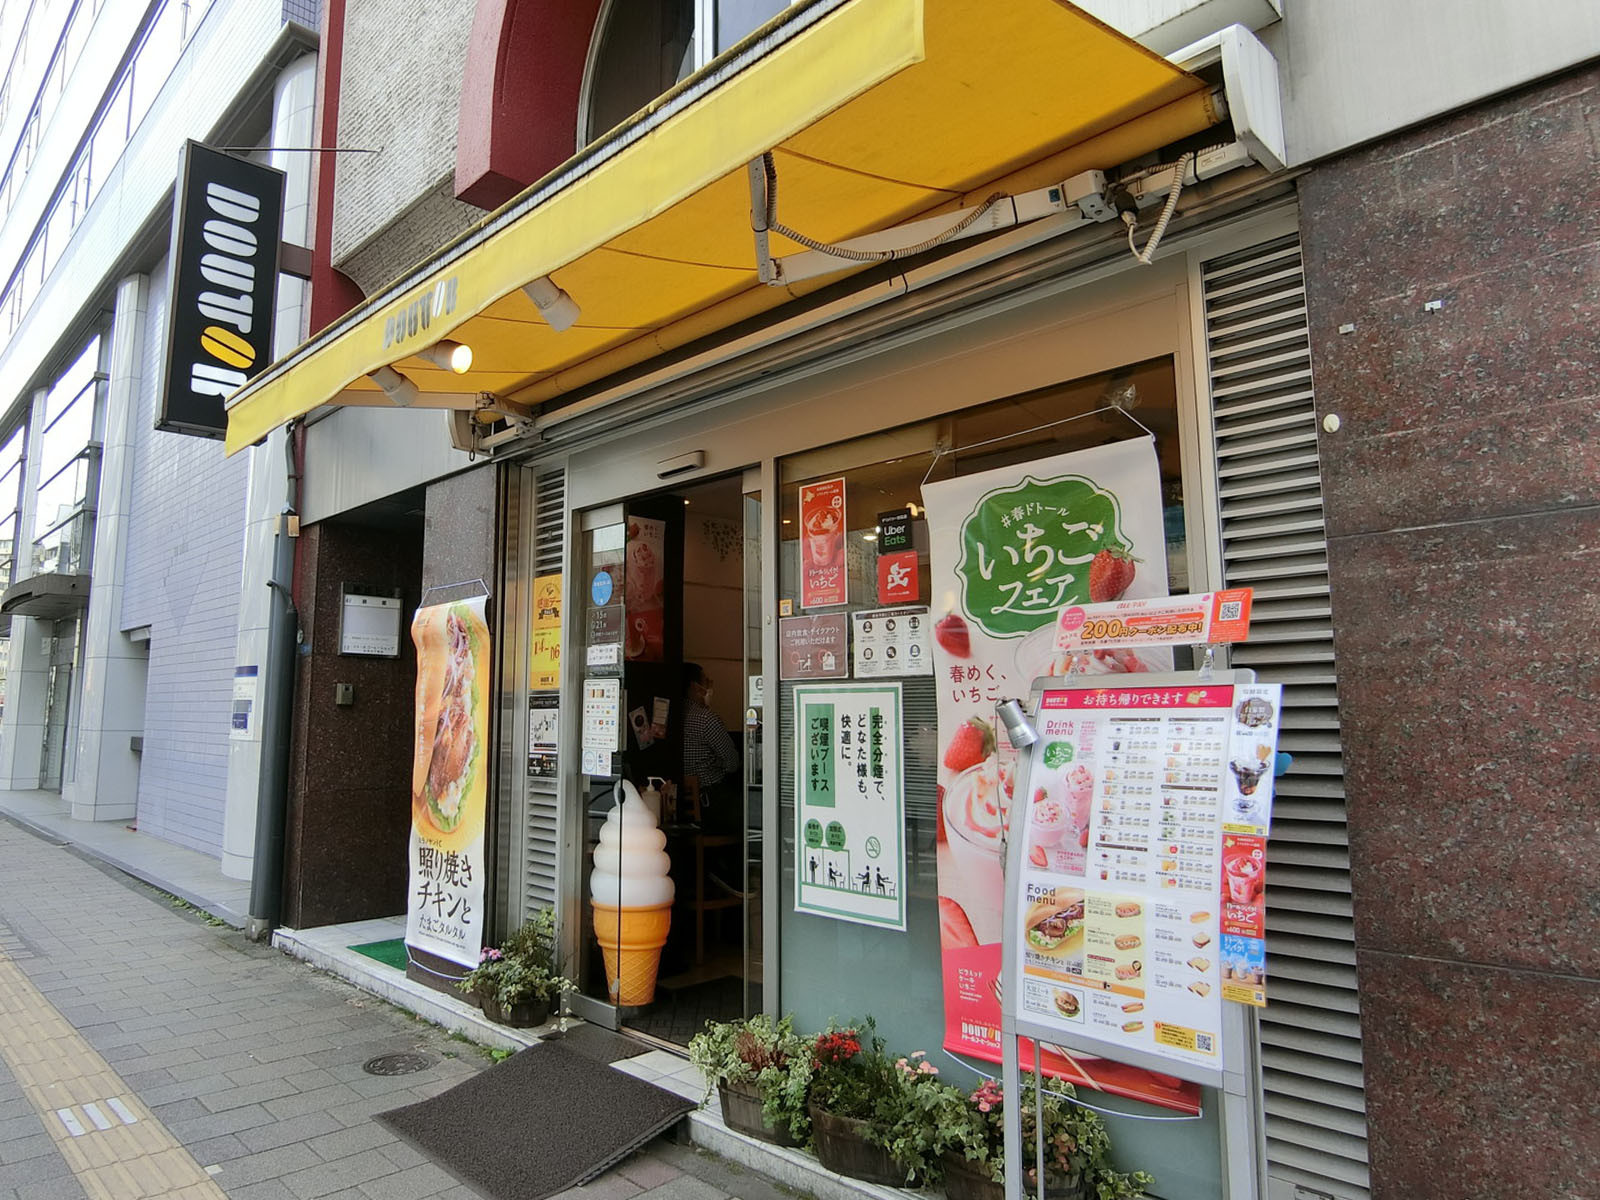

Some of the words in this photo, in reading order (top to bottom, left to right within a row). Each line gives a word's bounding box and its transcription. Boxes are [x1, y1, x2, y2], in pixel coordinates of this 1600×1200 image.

[191, 182, 260, 399] DOUTOR
[384, 276, 458, 351] DOUTOR
[884, 524, 906, 536] Uber
[884, 535, 906, 546] Eats
[977, 522, 1104, 581] いちご
[809, 573, 839, 589] いちご
[991, 573, 1079, 615] フェア
[1081, 619, 1203, 640] 200円クーポン配布中!
[949, 664, 1006, 683] 春めく、
[1083, 692, 1183, 706] お持ち帰りできます
[1045, 728, 1073, 736] menu
[1046, 720, 1074, 729] Drink
[841, 714, 852, 766] 快適に。
[811, 718, 820, 792] ございます
[819, 718, 830, 792] 喫煙ブース
[856, 714, 868, 800] どなた様も、
[871, 714, 885, 800] 完全分煙で、
[418, 847, 472, 888] 照り焼き
[417, 881, 472, 924] チキンと
[1026, 894, 1056, 906] menu
[1027, 883, 1056, 897] Food
[419, 914, 466, 940] たまごタルタル
[962, 1022, 1001, 1042] DOUTOR
